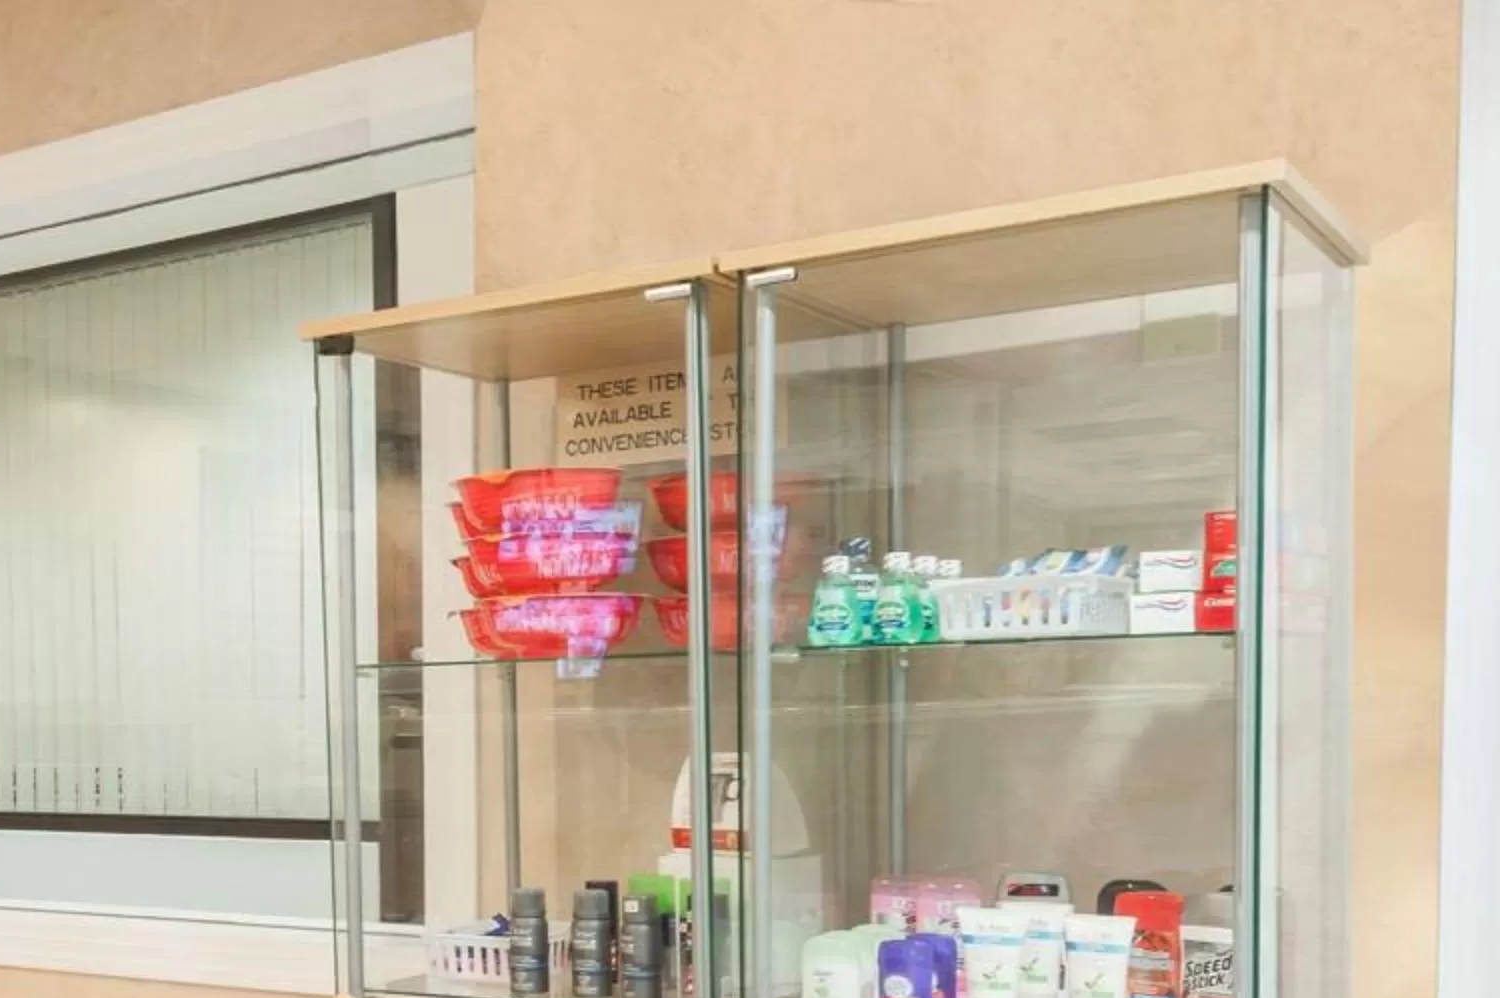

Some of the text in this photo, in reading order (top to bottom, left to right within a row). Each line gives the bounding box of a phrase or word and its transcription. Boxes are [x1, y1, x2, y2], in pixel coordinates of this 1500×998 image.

[577, 371, 688, 401] THESE ITEM
[573, 401, 673, 429] AVAILABLE
